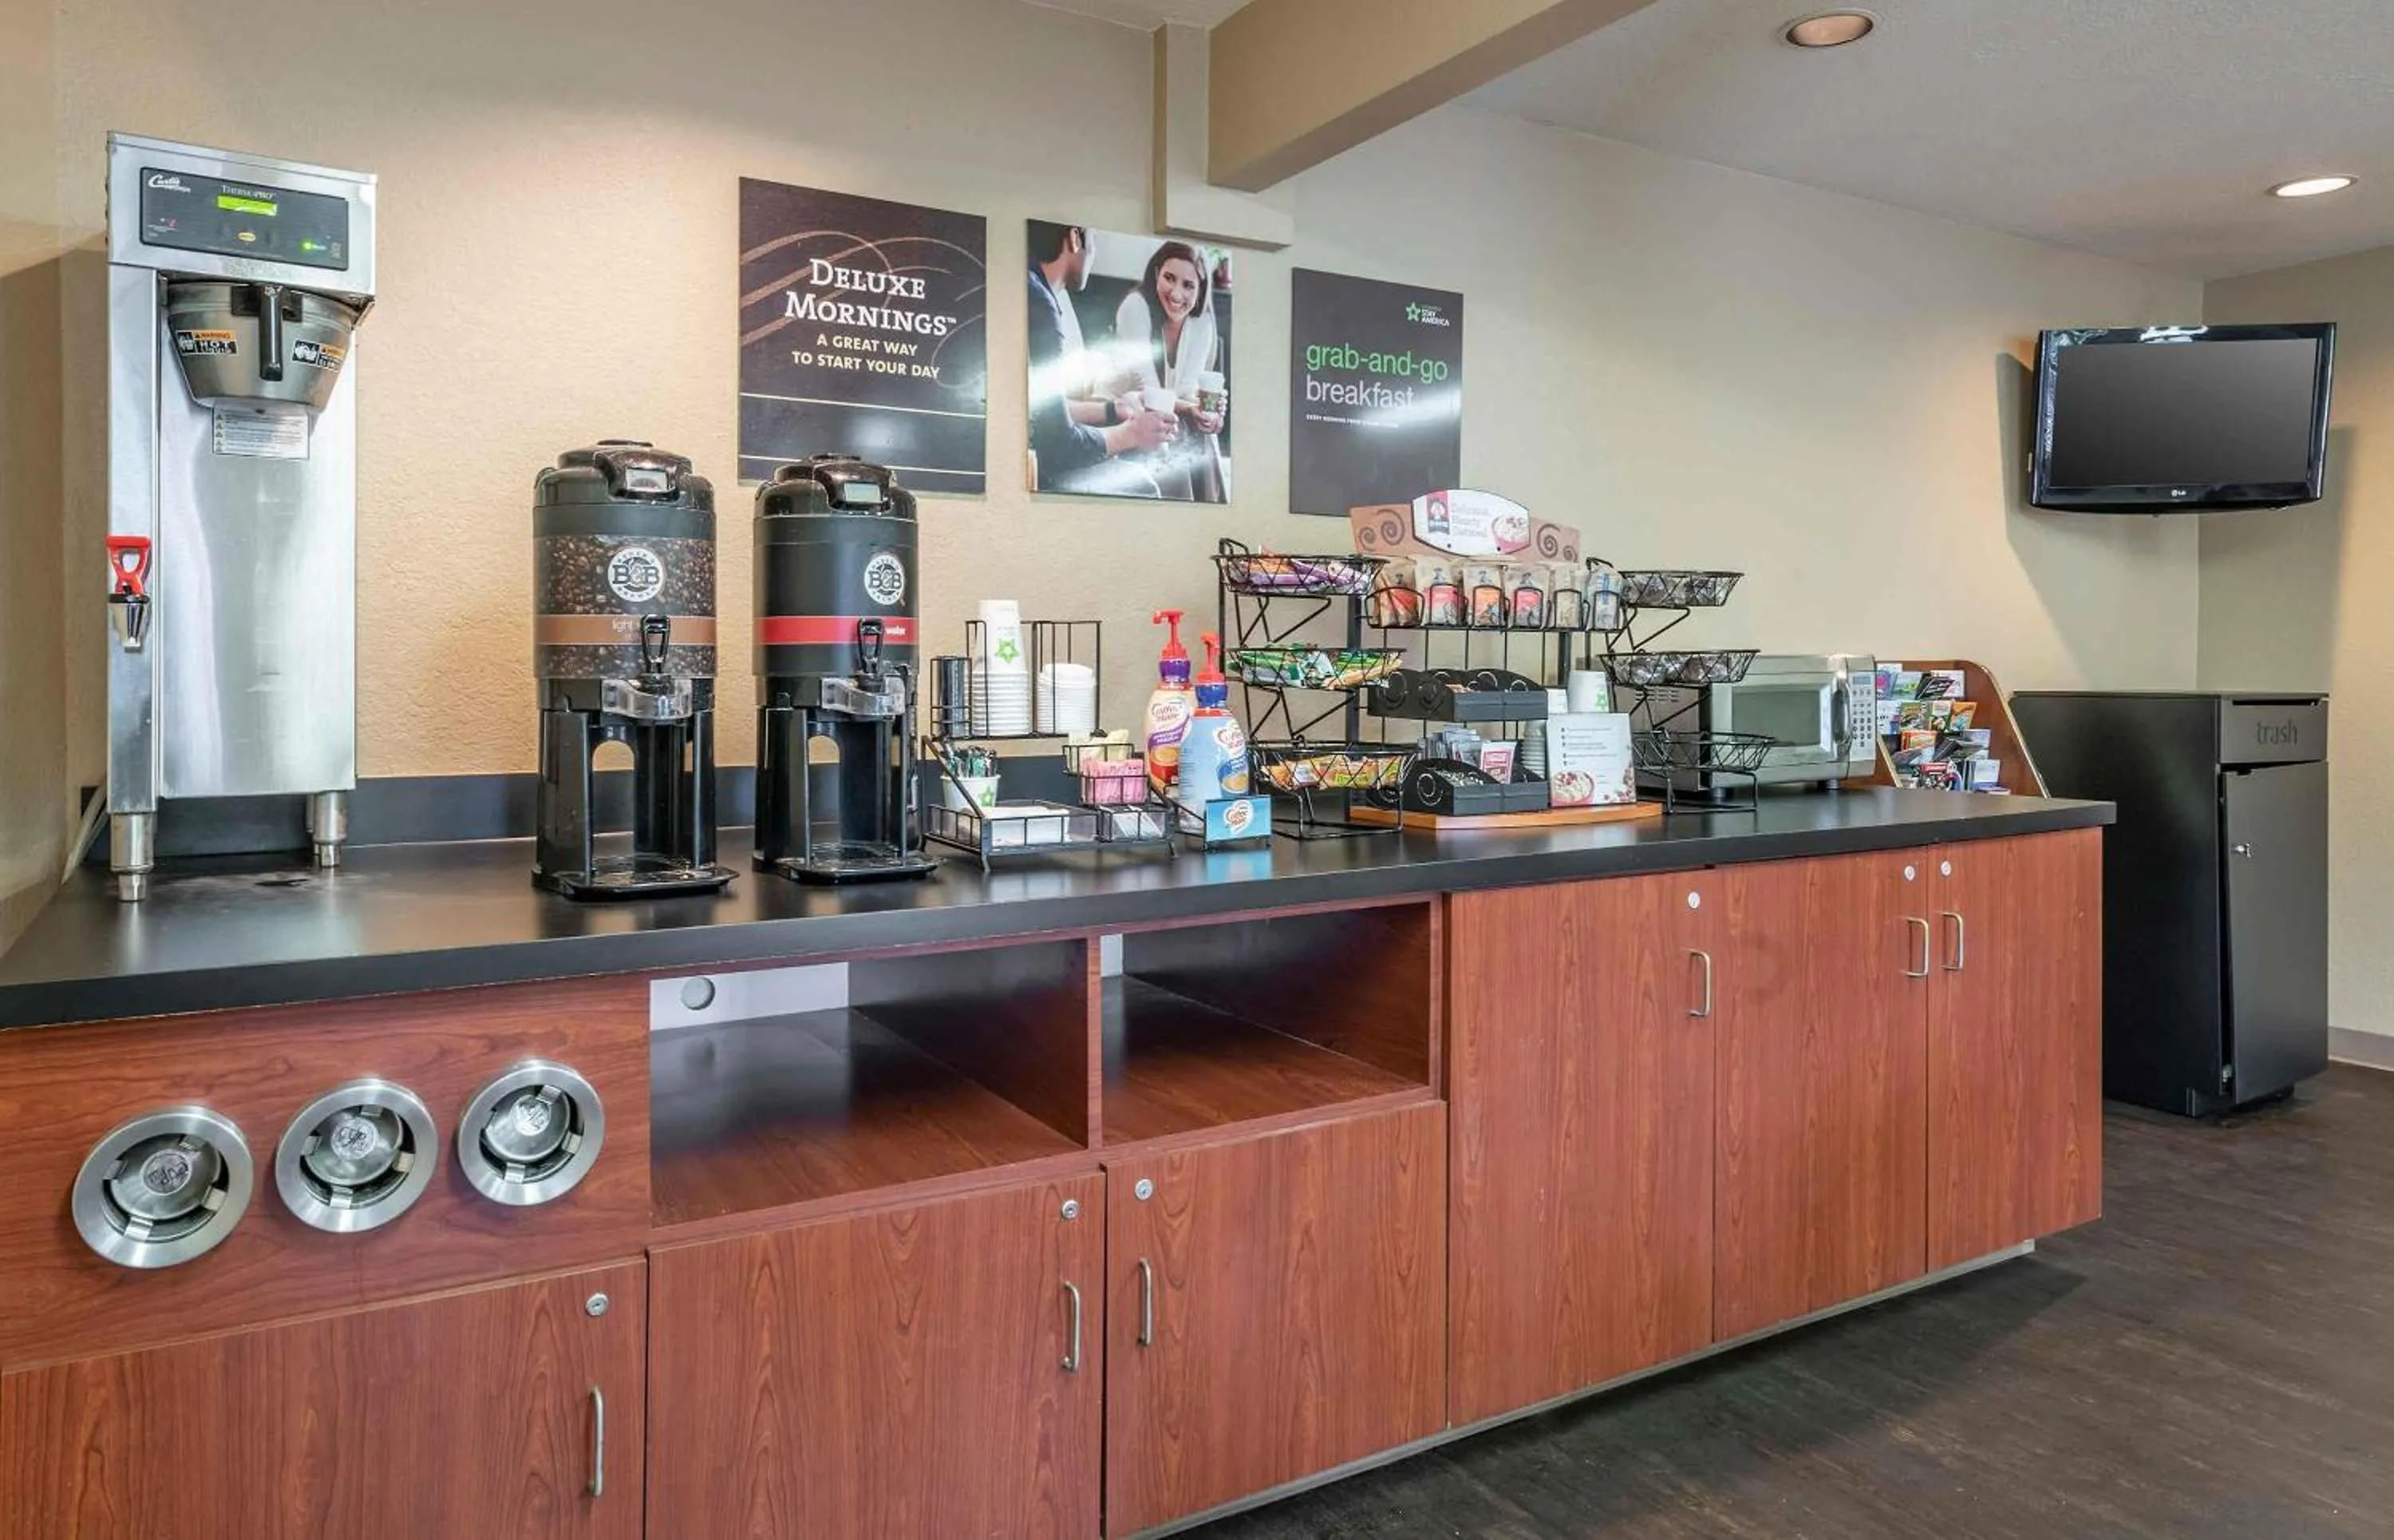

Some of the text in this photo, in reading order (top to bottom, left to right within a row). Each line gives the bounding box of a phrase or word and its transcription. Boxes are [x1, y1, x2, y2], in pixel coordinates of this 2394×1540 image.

[809, 258, 926, 299] DELUXE
[816, 334, 918, 357] A GREAT WAY
[792, 351, 940, 379] TO START YOUR DAY
[1306, 342, 1448, 385] grab-and-go
[1306, 373, 1413, 409] breakfast
[2257, 719, 2297, 744] trash
